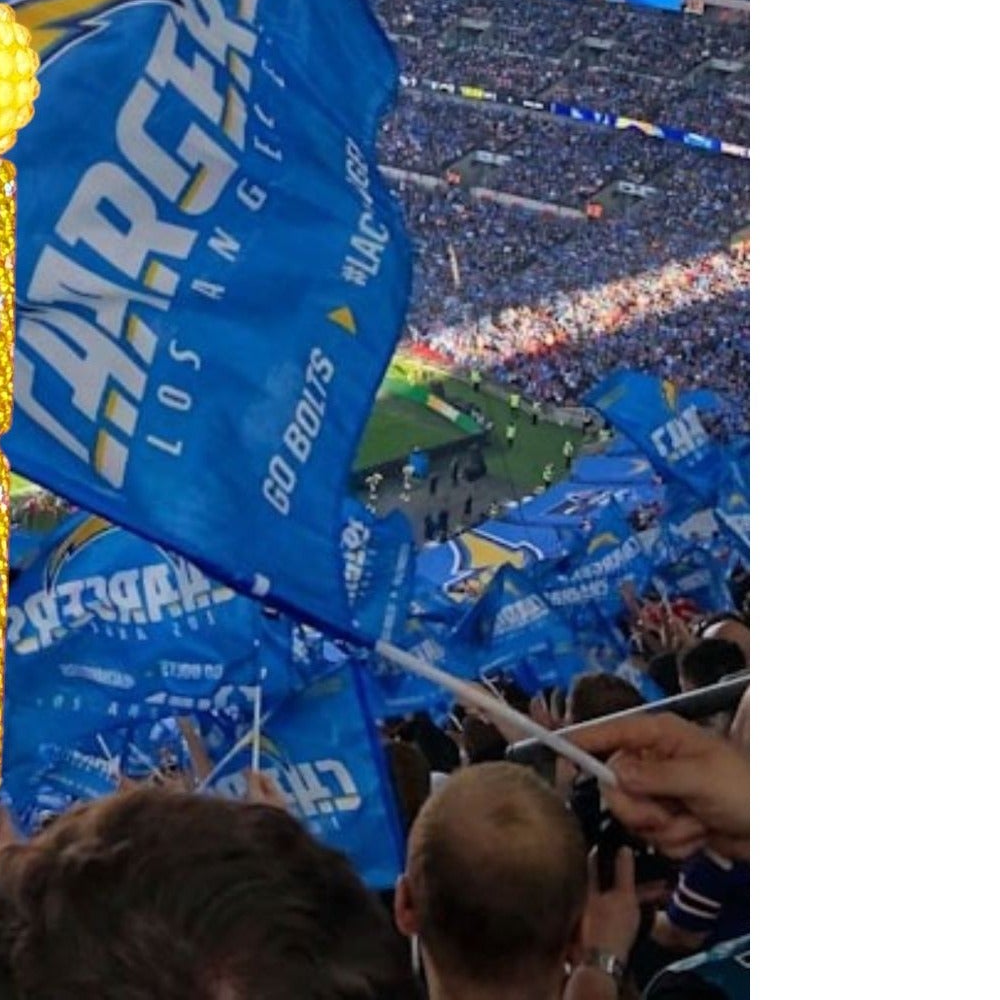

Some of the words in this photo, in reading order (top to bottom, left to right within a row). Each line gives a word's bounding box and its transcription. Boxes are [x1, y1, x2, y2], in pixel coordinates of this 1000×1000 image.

[147, 341, 200, 456] LOS
[263, 455, 297, 516] GO
[283, 347, 335, 464] BOLTS
